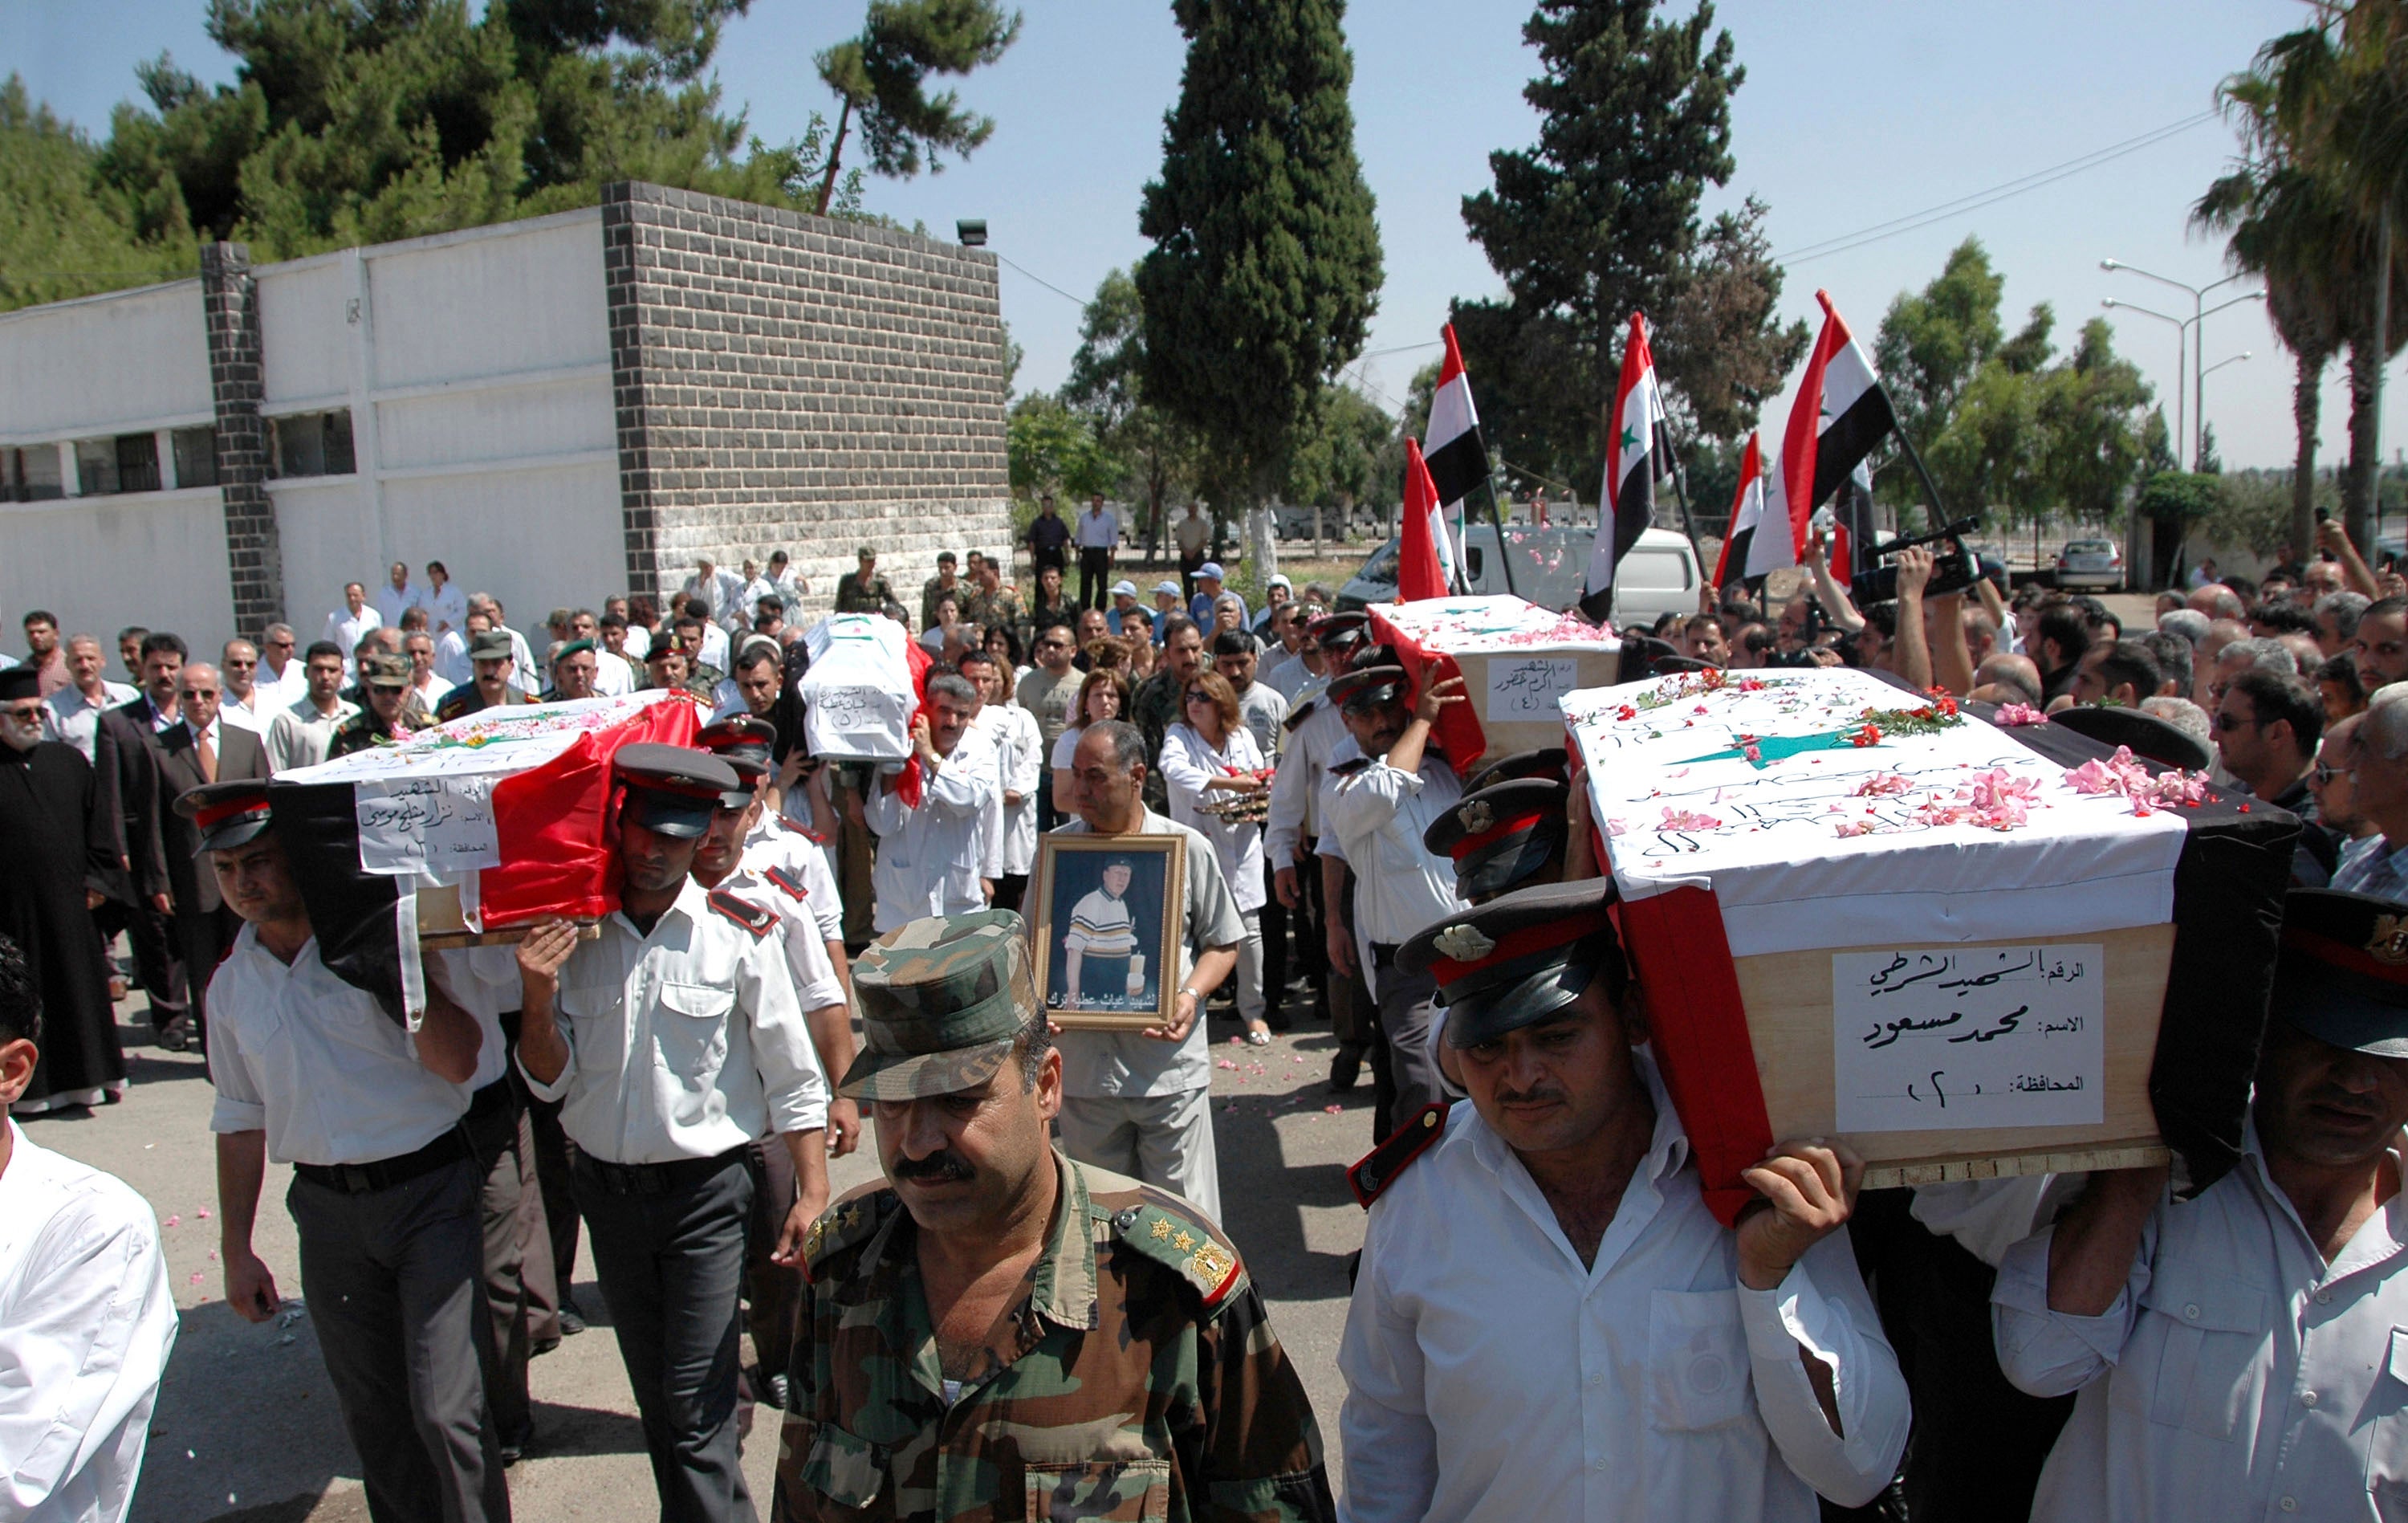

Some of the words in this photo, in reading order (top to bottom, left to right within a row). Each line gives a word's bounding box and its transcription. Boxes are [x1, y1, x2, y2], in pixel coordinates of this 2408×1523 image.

[390, 779, 449, 801] الشهيد
[417, 800, 454, 829] نزار
[1869, 951, 1956, 996] الشرطي
[1938, 948, 2044, 997] الشهيد
[2040, 960, 2085, 987] الرقم:
[1129, 993, 1157, 1010] لشهيد
[1862, 1012, 1963, 1050] مسعود
[1946, 1004, 2029, 1043] محمد
[2037, 1016, 2085, 1038] الاسم:
[2008, 1073, 2085, 1093] المحافظة:
